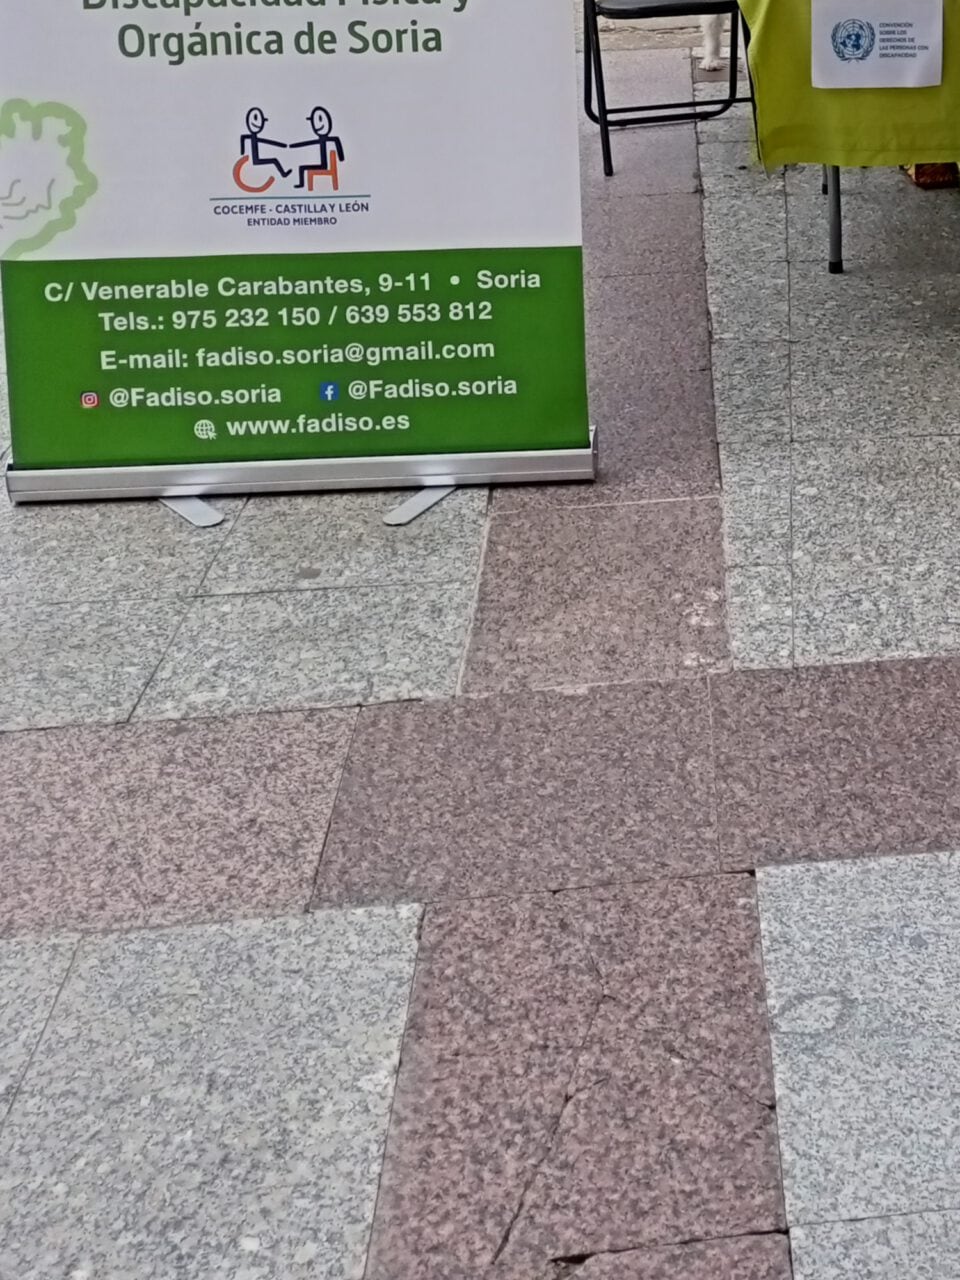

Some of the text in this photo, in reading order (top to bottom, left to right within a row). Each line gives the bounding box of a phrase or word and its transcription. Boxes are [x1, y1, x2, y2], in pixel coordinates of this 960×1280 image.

[118, 19, 443, 65] Orgánica de Soria
[213, 205, 267, 215] COCEMFE
[275, 204, 326, 214] CASTILLA
[339, 200, 369, 213] LEÓN
[247, 216, 337, 226] ENTIDAD MIEMBRO
[44, 269, 541, 302] C/ Venerable Carabantes, 9-11 Soria
[98, 301, 493, 331] Tels.: 975 232 150 / 639 553 812
[100, 340, 495, 370] E-mail: fadiso.soria@gmail.com
[109, 384, 281, 408] @Fadiso.soria
[348, 376, 517, 400] @Fadiso.soria
[226, 413, 410, 436] www.fadiso.es
